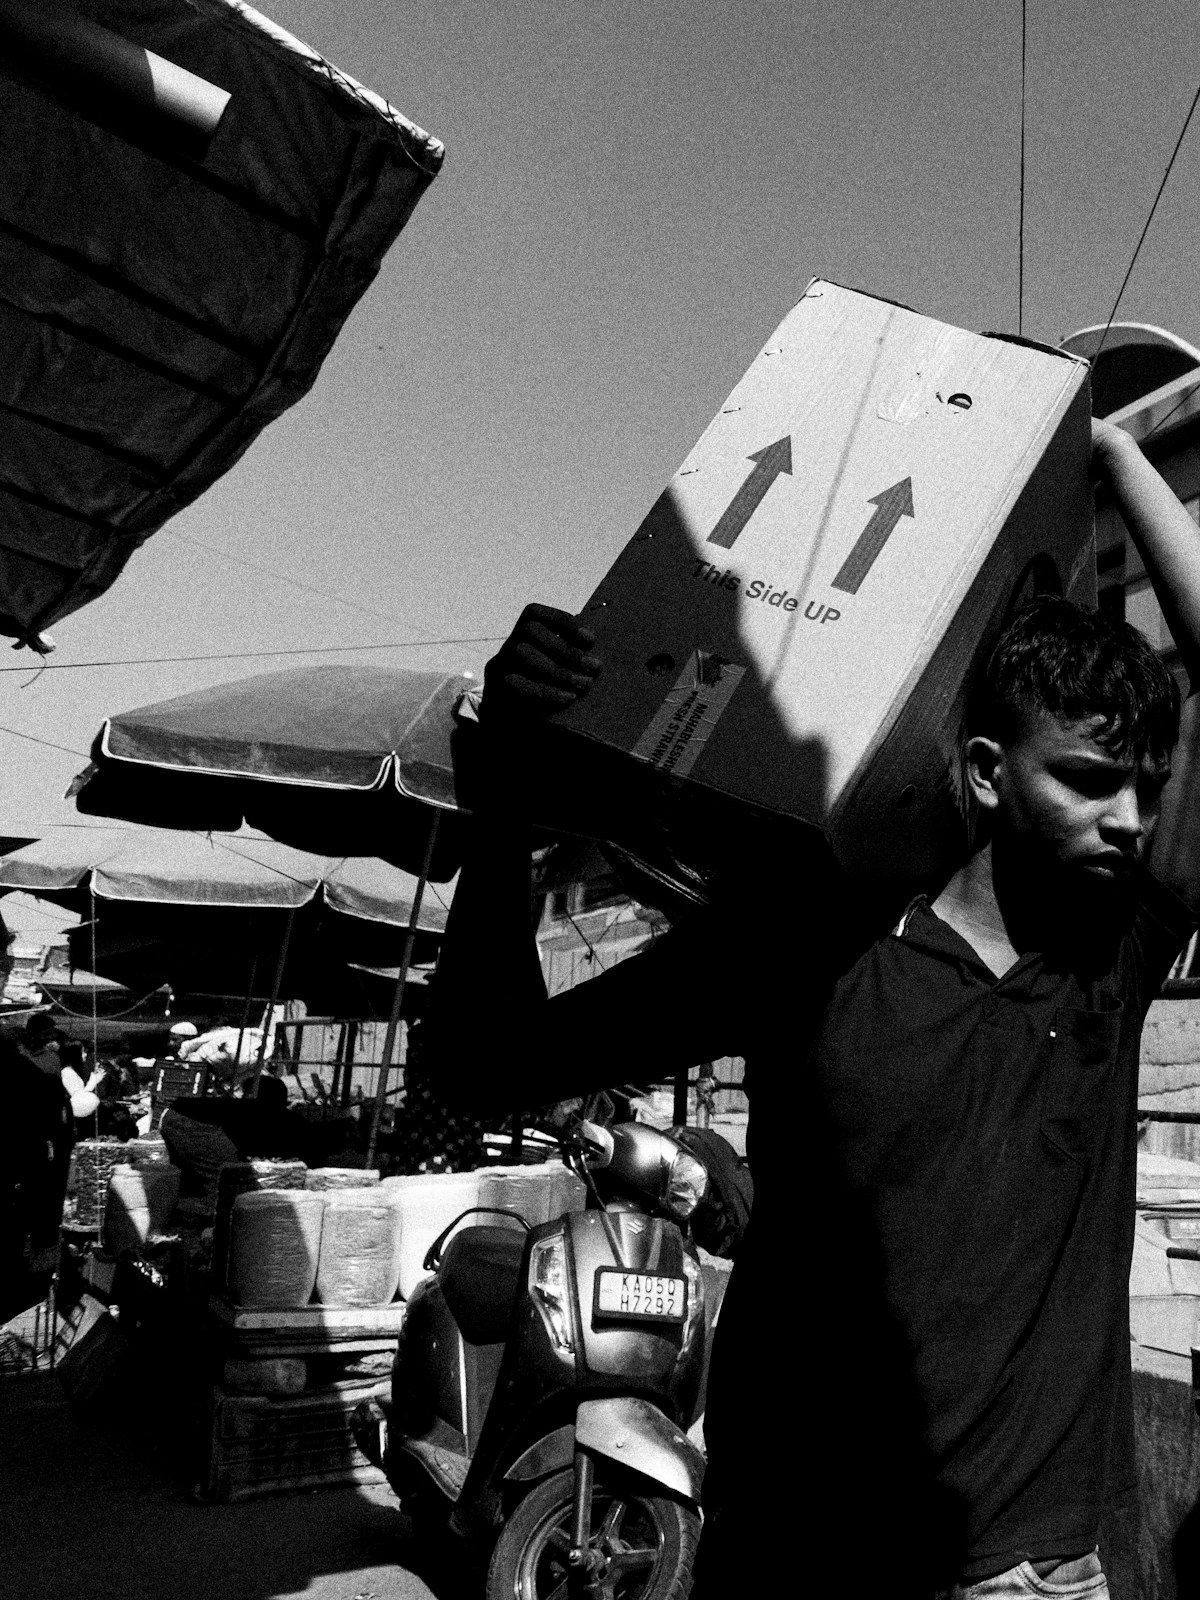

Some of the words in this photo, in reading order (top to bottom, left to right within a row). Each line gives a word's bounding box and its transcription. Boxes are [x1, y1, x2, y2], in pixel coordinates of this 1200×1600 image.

[692, 558, 741, 591] This
[745, 580, 799, 612] Side
[804, 601, 841, 624] UP
[673, 690, 700, 723] FRESH
[620, 1294, 675, 1316] H7292
